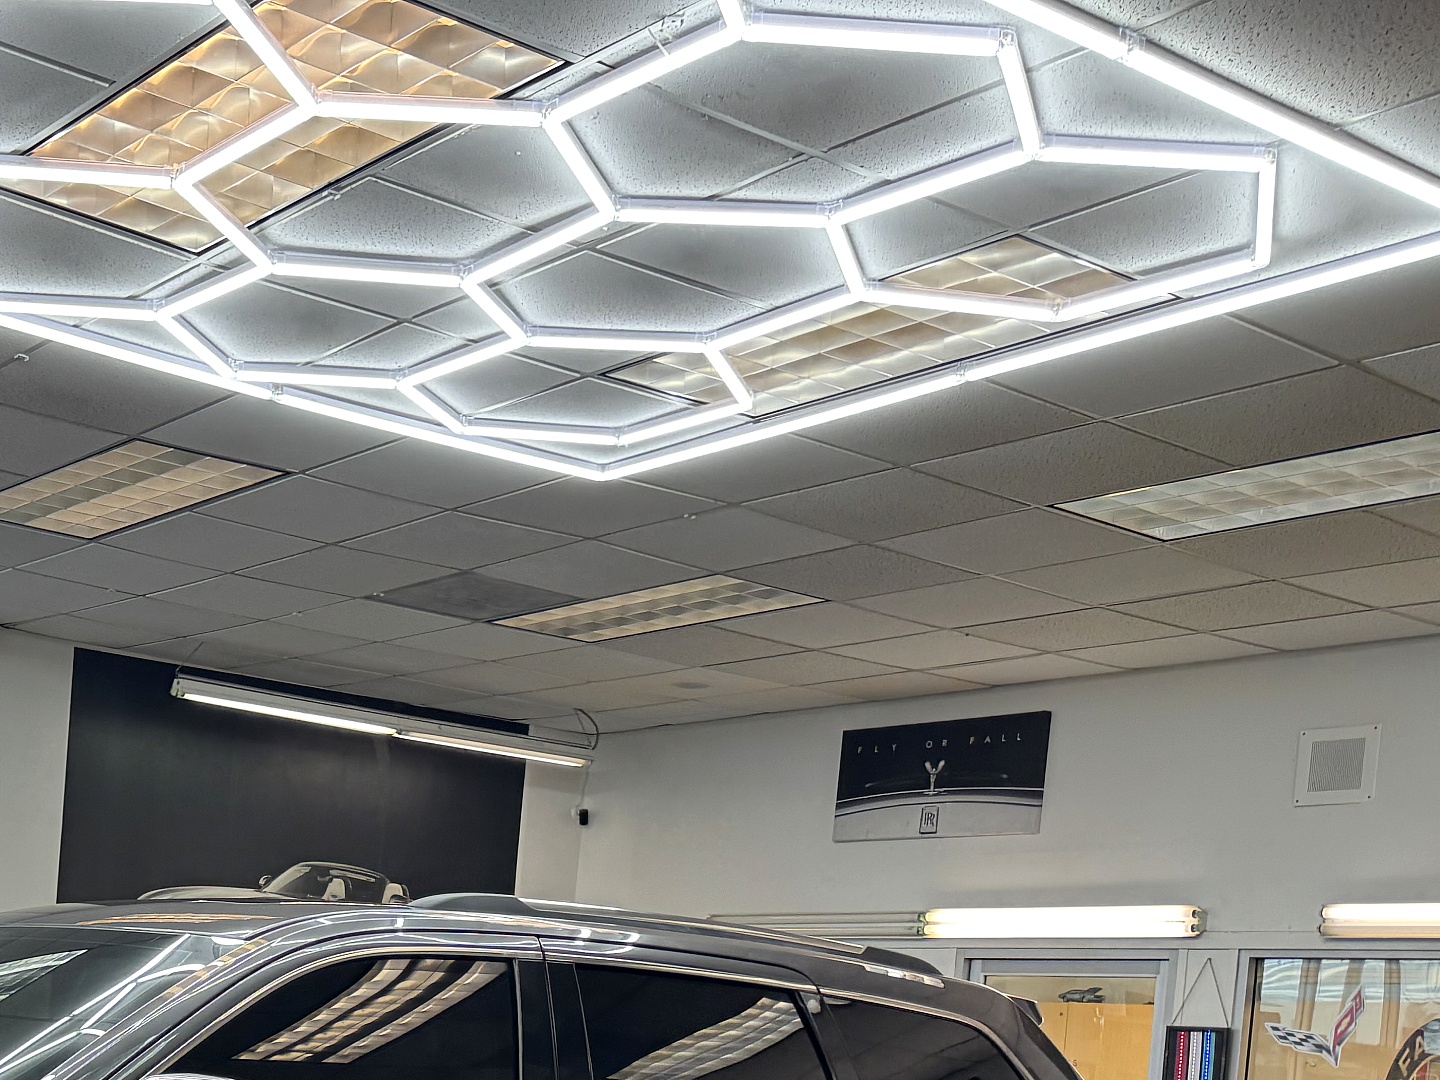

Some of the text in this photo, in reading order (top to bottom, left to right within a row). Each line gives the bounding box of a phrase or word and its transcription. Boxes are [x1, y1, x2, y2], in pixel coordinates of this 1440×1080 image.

[857, 733, 1021, 754] FLY OR FALL
